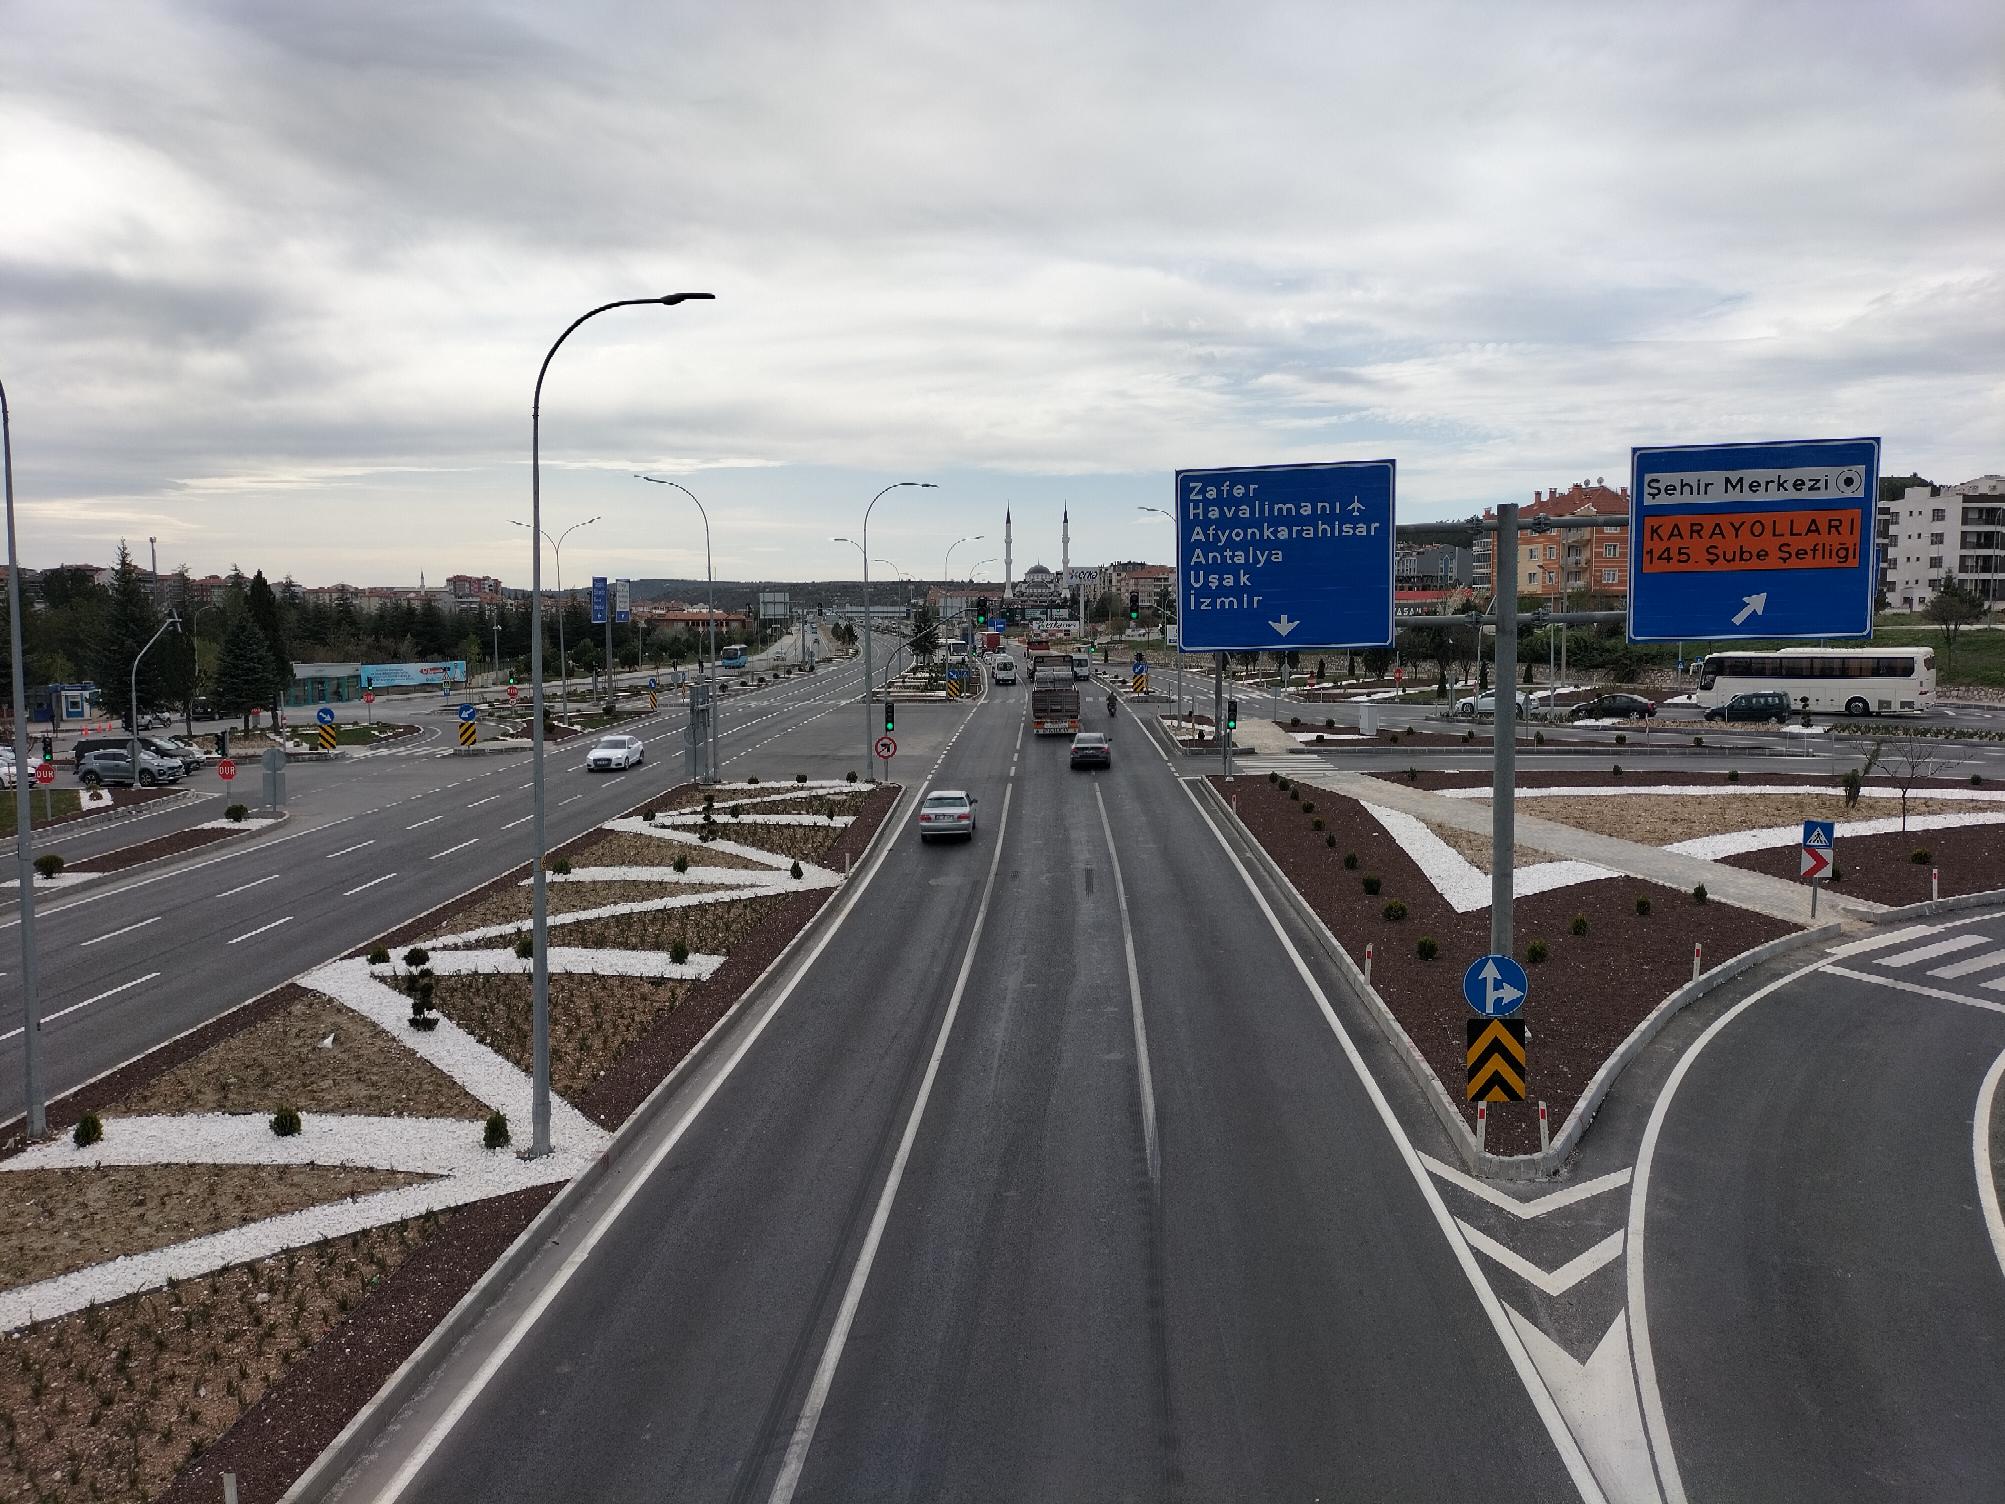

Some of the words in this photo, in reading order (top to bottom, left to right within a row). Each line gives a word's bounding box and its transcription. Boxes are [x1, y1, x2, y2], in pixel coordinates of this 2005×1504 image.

[1189, 480, 1259, 500] Zafer
[1647, 478, 1714, 500] Şehir
[1724, 474, 1829, 494] Merkezi
[1189, 500, 1340, 520] Havalimanı
[1190, 520, 1380, 546] Afyonkarahisar
[1650, 518, 1855, 541] KARAYOLLARI
[1190, 546, 1283, 568] Antalya
[1645, 546, 1700, 565] 145.
[1705, 544, 1769, 566] Şube
[1778, 542, 1857, 565] Şefliği
[1190, 569, 1252, 590] Uşak
[1190, 589, 1263, 610] İzmir
[36, 770, 54, 778] DUR
[219, 766, 235, 775] DUR
